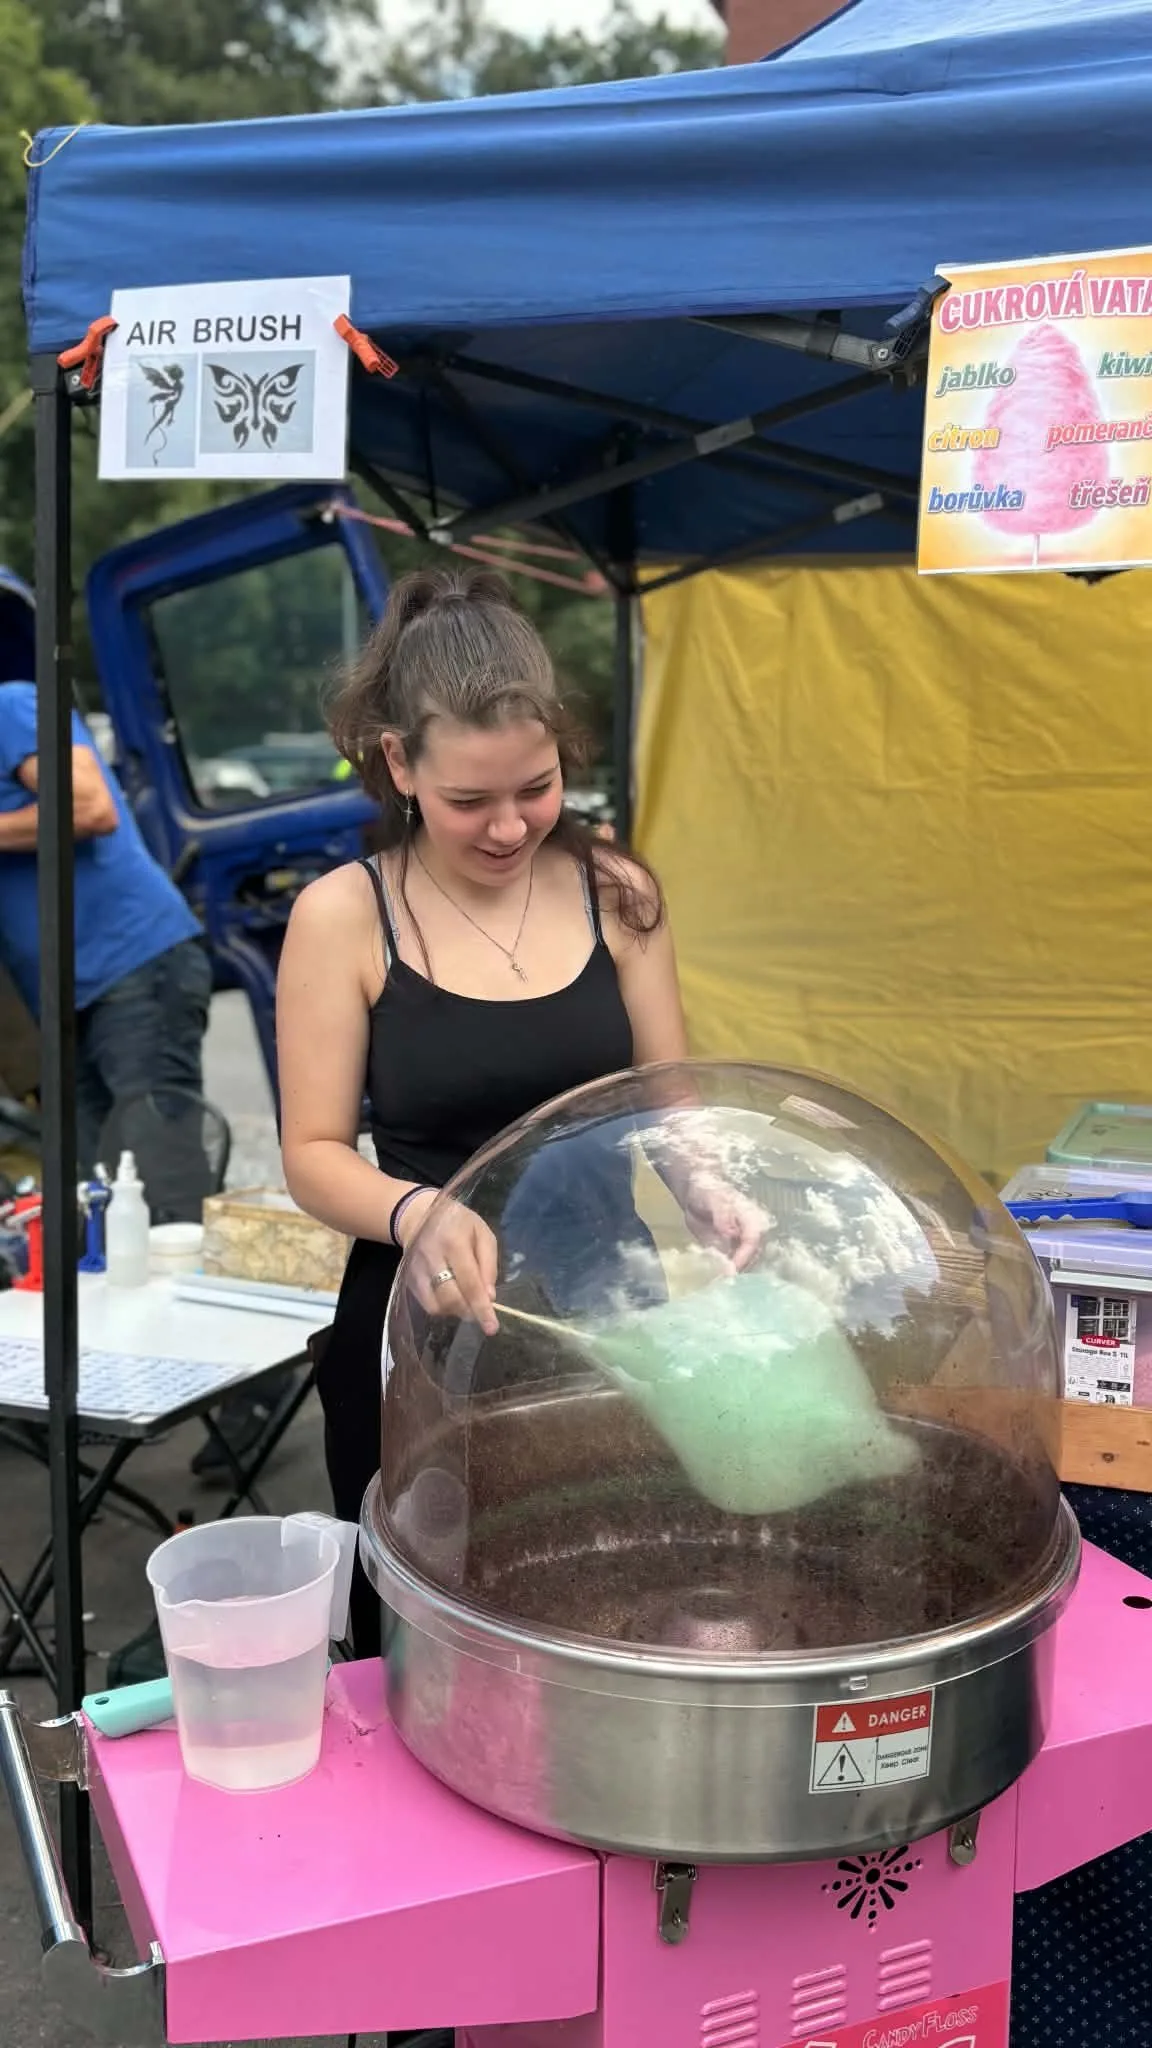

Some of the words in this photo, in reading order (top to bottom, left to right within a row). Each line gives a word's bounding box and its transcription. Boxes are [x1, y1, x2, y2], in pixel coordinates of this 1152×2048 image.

[941, 270, 1084, 331] CUKROVÁ
[126, 320, 176, 346] AIR
[193, 314, 301, 343] BRUSH
[936, 361, 1016, 396] jablko
[928, 424, 1000, 451] citron
[927, 484, 1025, 513] borůvka
[1069, 477, 1150, 509] třešeň
[1085, 1337, 1116, 1346] CURVER
[868, 1705, 927, 1727] DANGER
